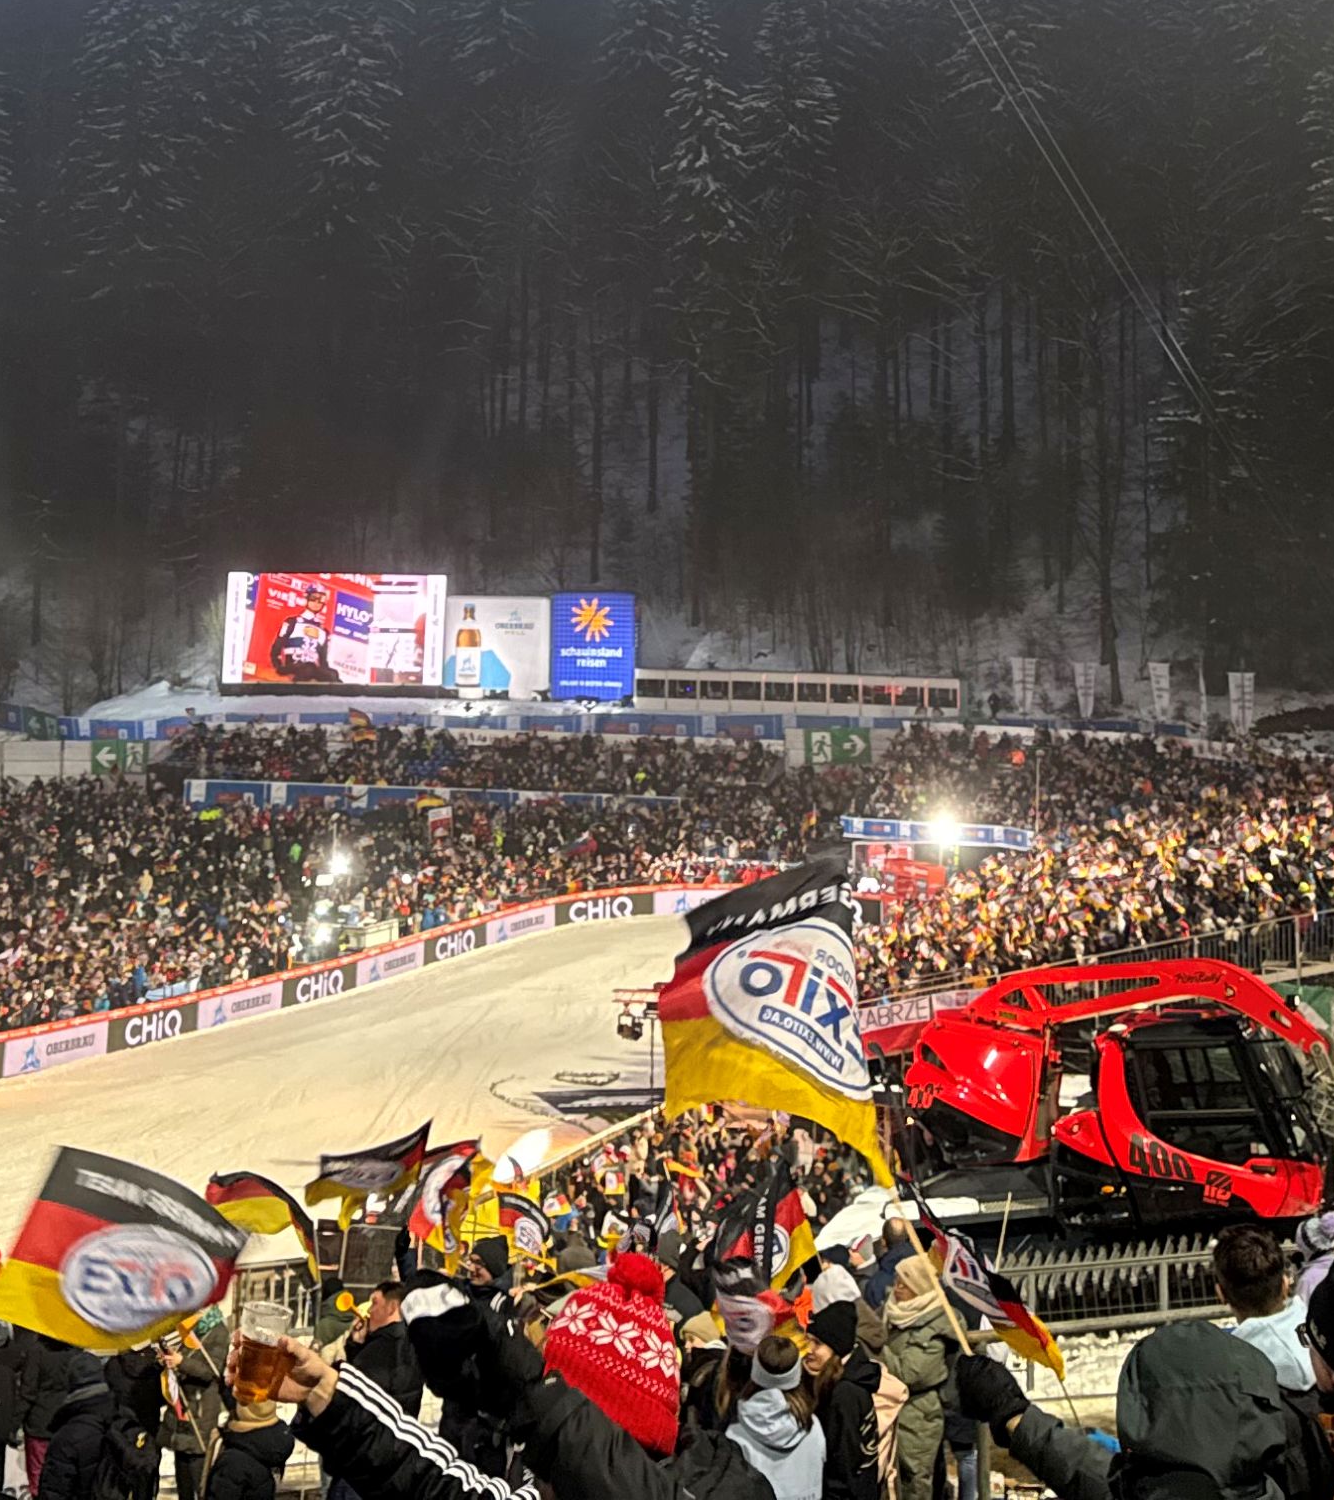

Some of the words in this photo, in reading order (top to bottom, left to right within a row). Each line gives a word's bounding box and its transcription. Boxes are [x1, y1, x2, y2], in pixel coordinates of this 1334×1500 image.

[560, 646, 623, 658] schauinsland
[576, 658, 607, 668] reisen
[1129, 1132, 1195, 1181] 400
